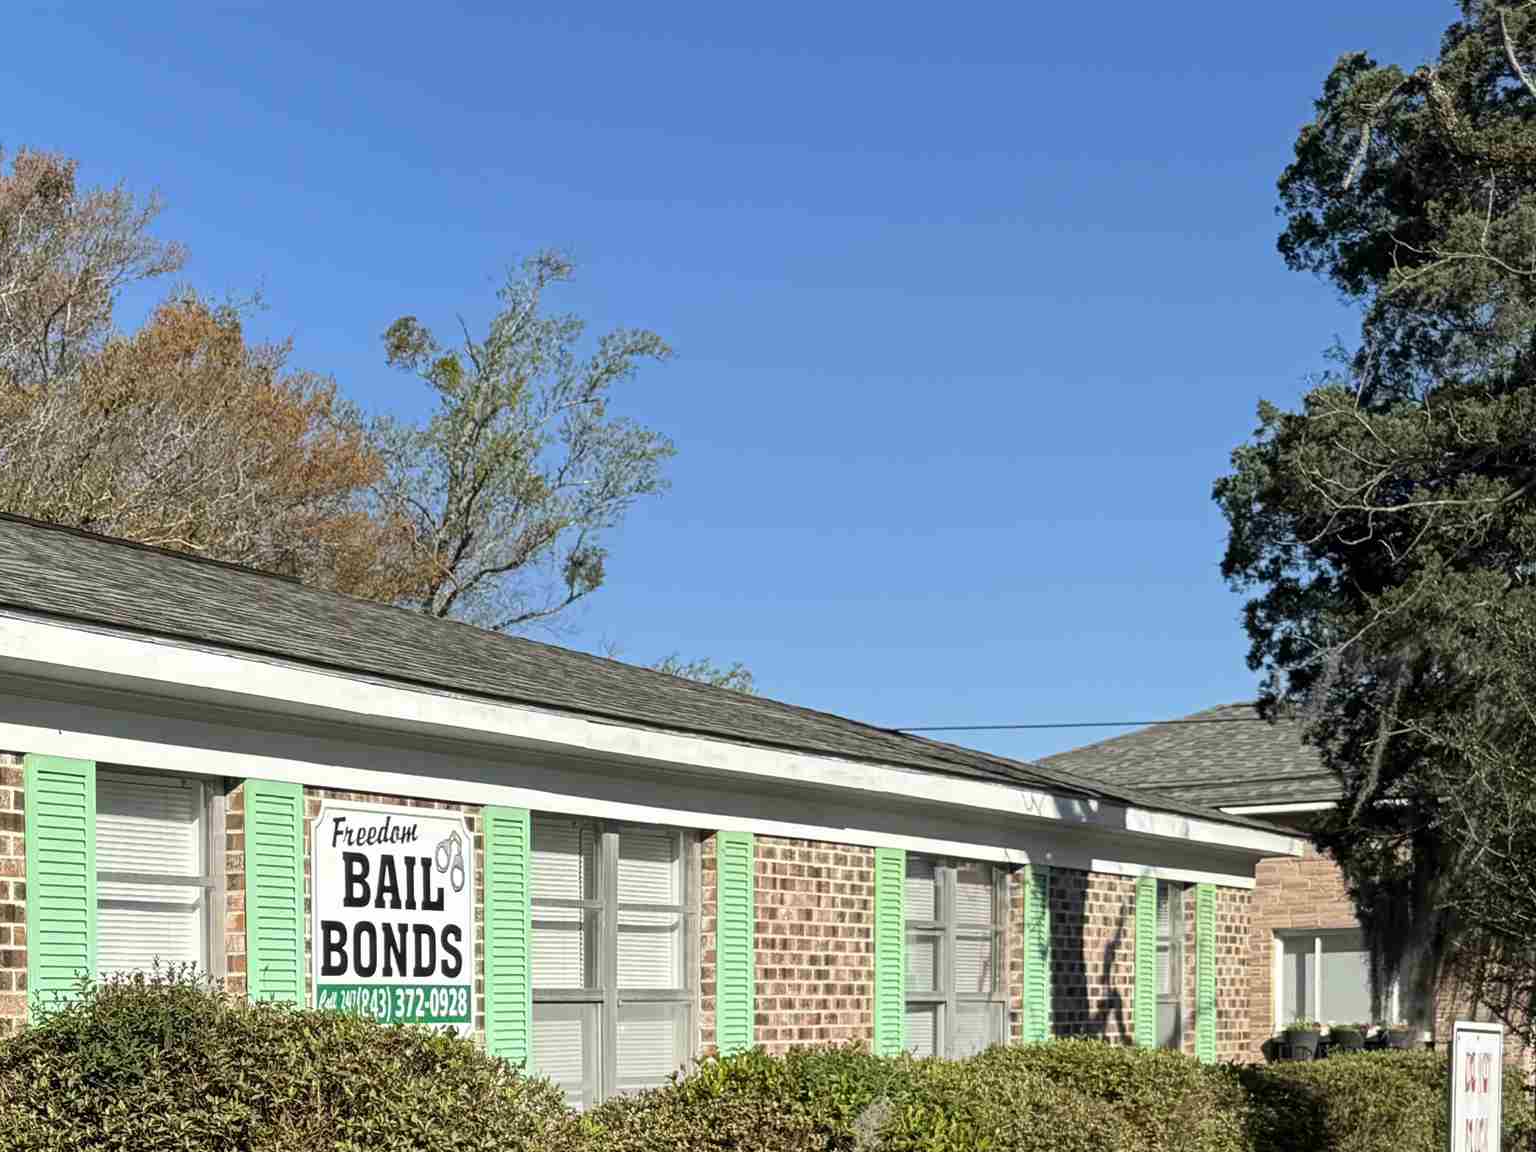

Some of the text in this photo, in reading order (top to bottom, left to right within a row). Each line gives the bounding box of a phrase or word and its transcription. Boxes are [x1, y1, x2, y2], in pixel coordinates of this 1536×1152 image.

[332, 816, 418, 848] Freedom
[342, 851, 445, 911] BAIL
[321, 919, 463, 979] BONDS
[357, 986, 391, 1022] (843)
[395, 987, 468, 1018] 372-0928
